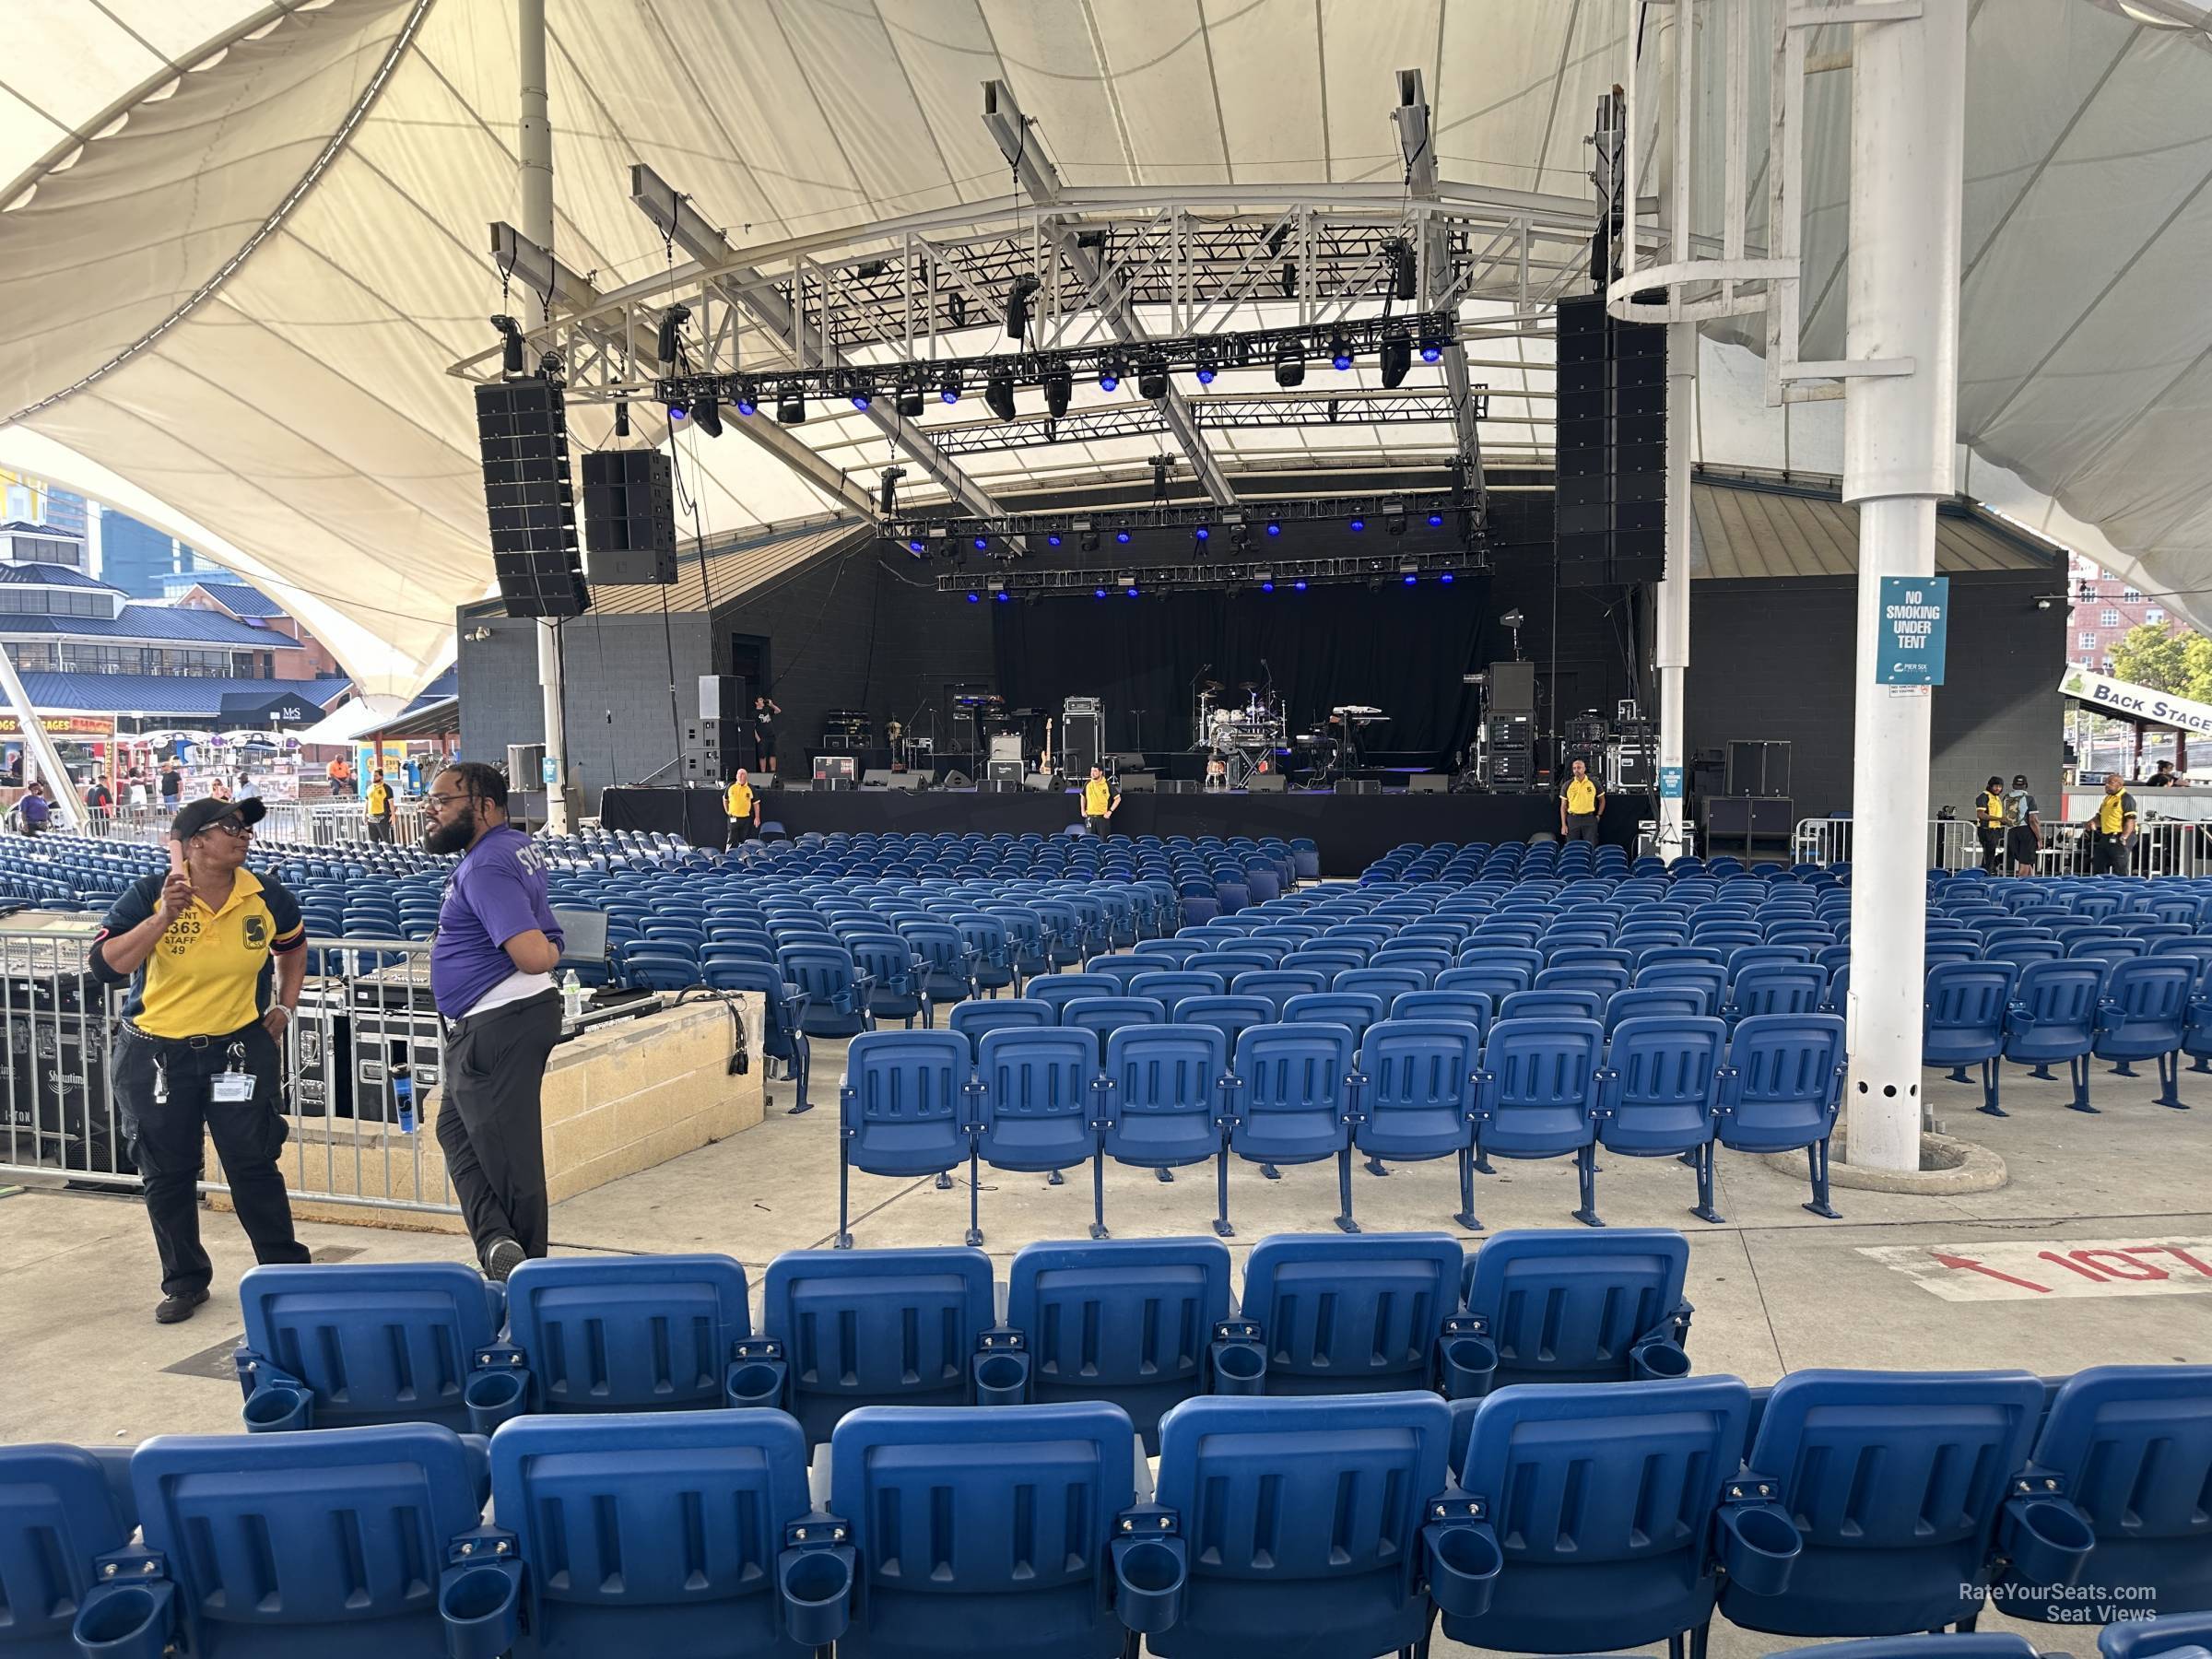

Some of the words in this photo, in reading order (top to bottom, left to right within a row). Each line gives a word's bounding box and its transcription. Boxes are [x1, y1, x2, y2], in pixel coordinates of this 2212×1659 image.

[1905, 591, 1923, 605] NO
[1886, 605, 1940, 620] SMOKING
[1893, 619, 1932, 634] UNDER
[1897, 635, 1927, 649] TENT
[2092, 684, 2145, 712] BACK
[2152, 701, 2212, 731] STAGE
[41, 720, 70, 731] SAGES
[164, 935, 197, 945] STAFF
[171, 946, 185, 955] 49
[49, 1070, 86, 1085] Shwtim
[2037, 1246, 2212, 1282] 107
